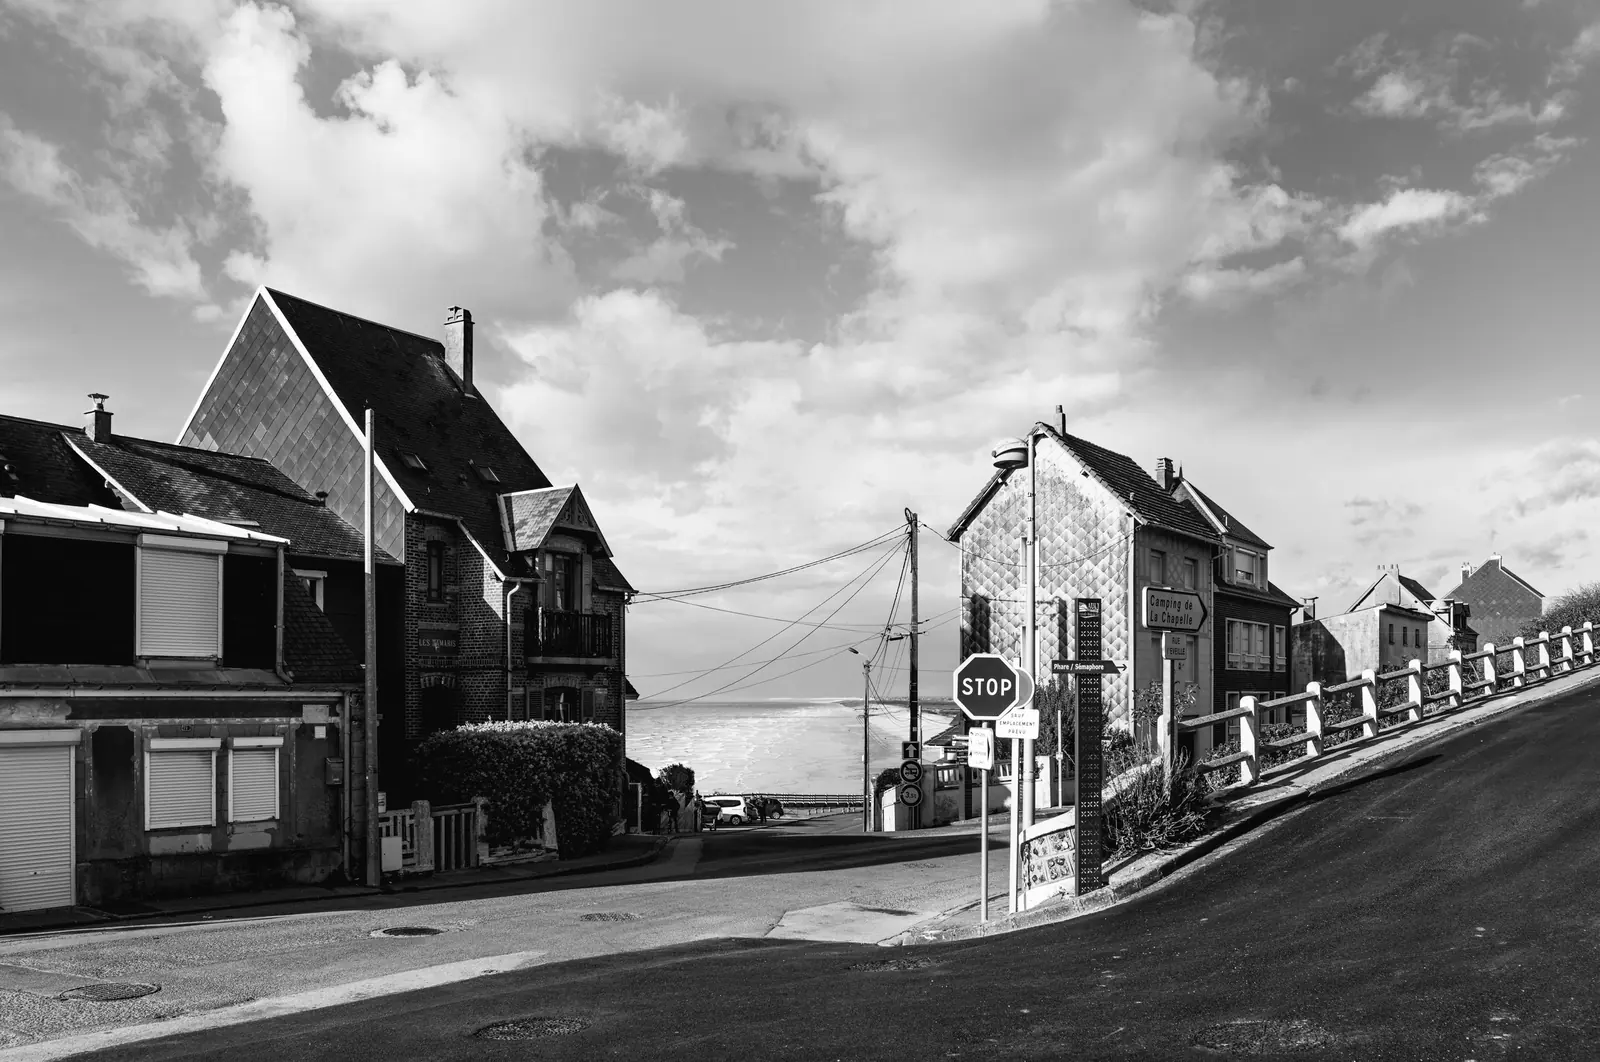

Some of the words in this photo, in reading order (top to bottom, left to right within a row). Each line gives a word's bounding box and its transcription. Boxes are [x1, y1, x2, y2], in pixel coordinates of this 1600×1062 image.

[1150, 594, 1181, 612] Camping
[1184, 599, 1193, 611] de
[1150, 610, 1158, 622] La
[1162, 611, 1193, 627] Chapelle
[418, 638, 431, 647] LES
[1171, 636, 1181, 645] RUE
[1074, 662, 1105, 671] Sémaphore
[961, 677, 1012, 697] STOP
